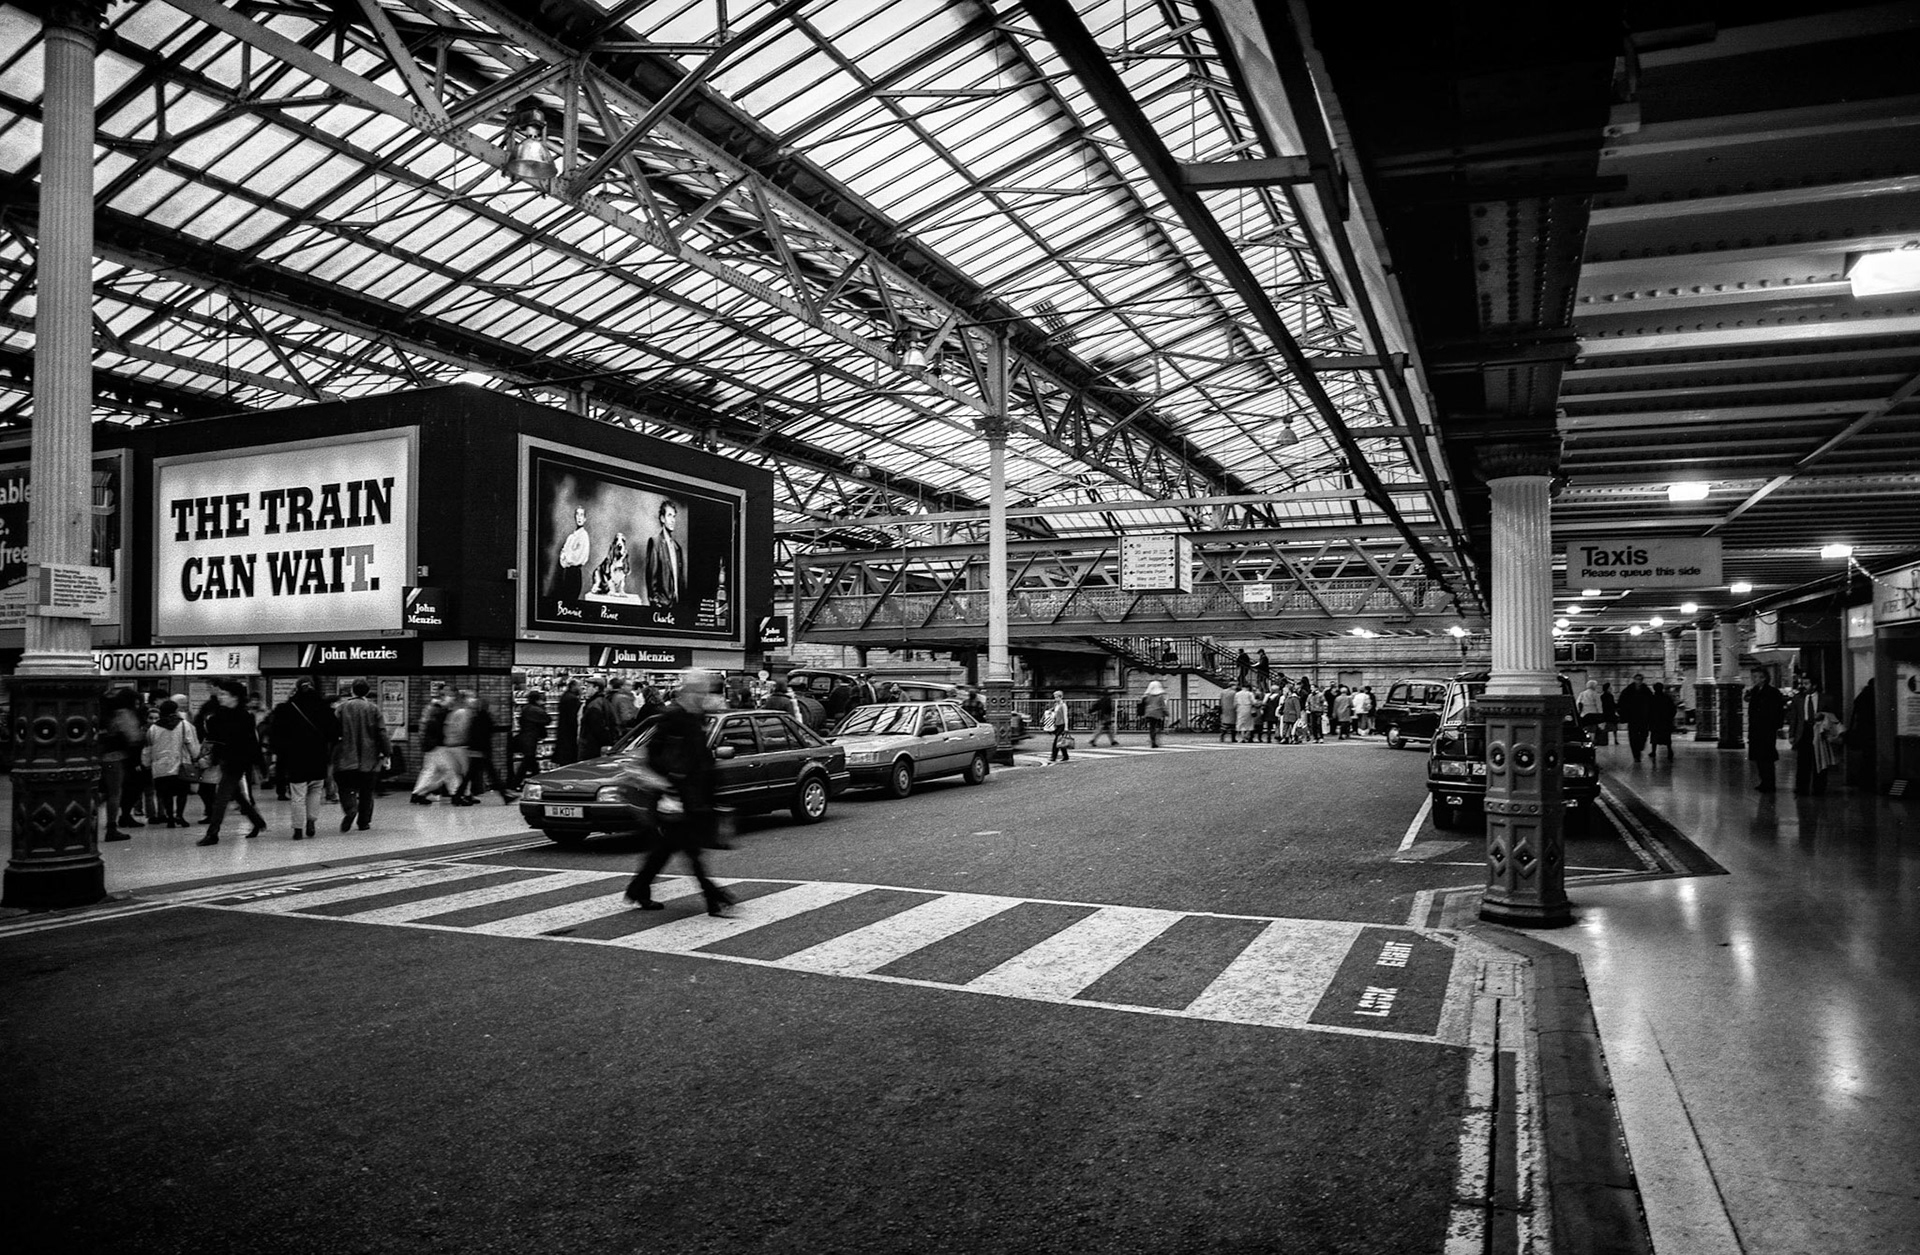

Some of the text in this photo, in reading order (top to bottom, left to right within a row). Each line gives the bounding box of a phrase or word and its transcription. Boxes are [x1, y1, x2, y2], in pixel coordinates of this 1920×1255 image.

[171, 477, 395, 542] THE TRAIN
[1580, 545, 1648, 566] Taxis
[181, 544, 380, 602] CAN WAIT.
[1582, 566, 1701, 578] Please queue this side
[414, 604, 436, 614] John
[408, 615, 442, 625] Menzies
[765, 628, 780, 636] John
[319, 646, 398, 663] John Menzies
[613, 651, 675, 664] John Menzies
[1354, 986, 1398, 1016] LOOK
